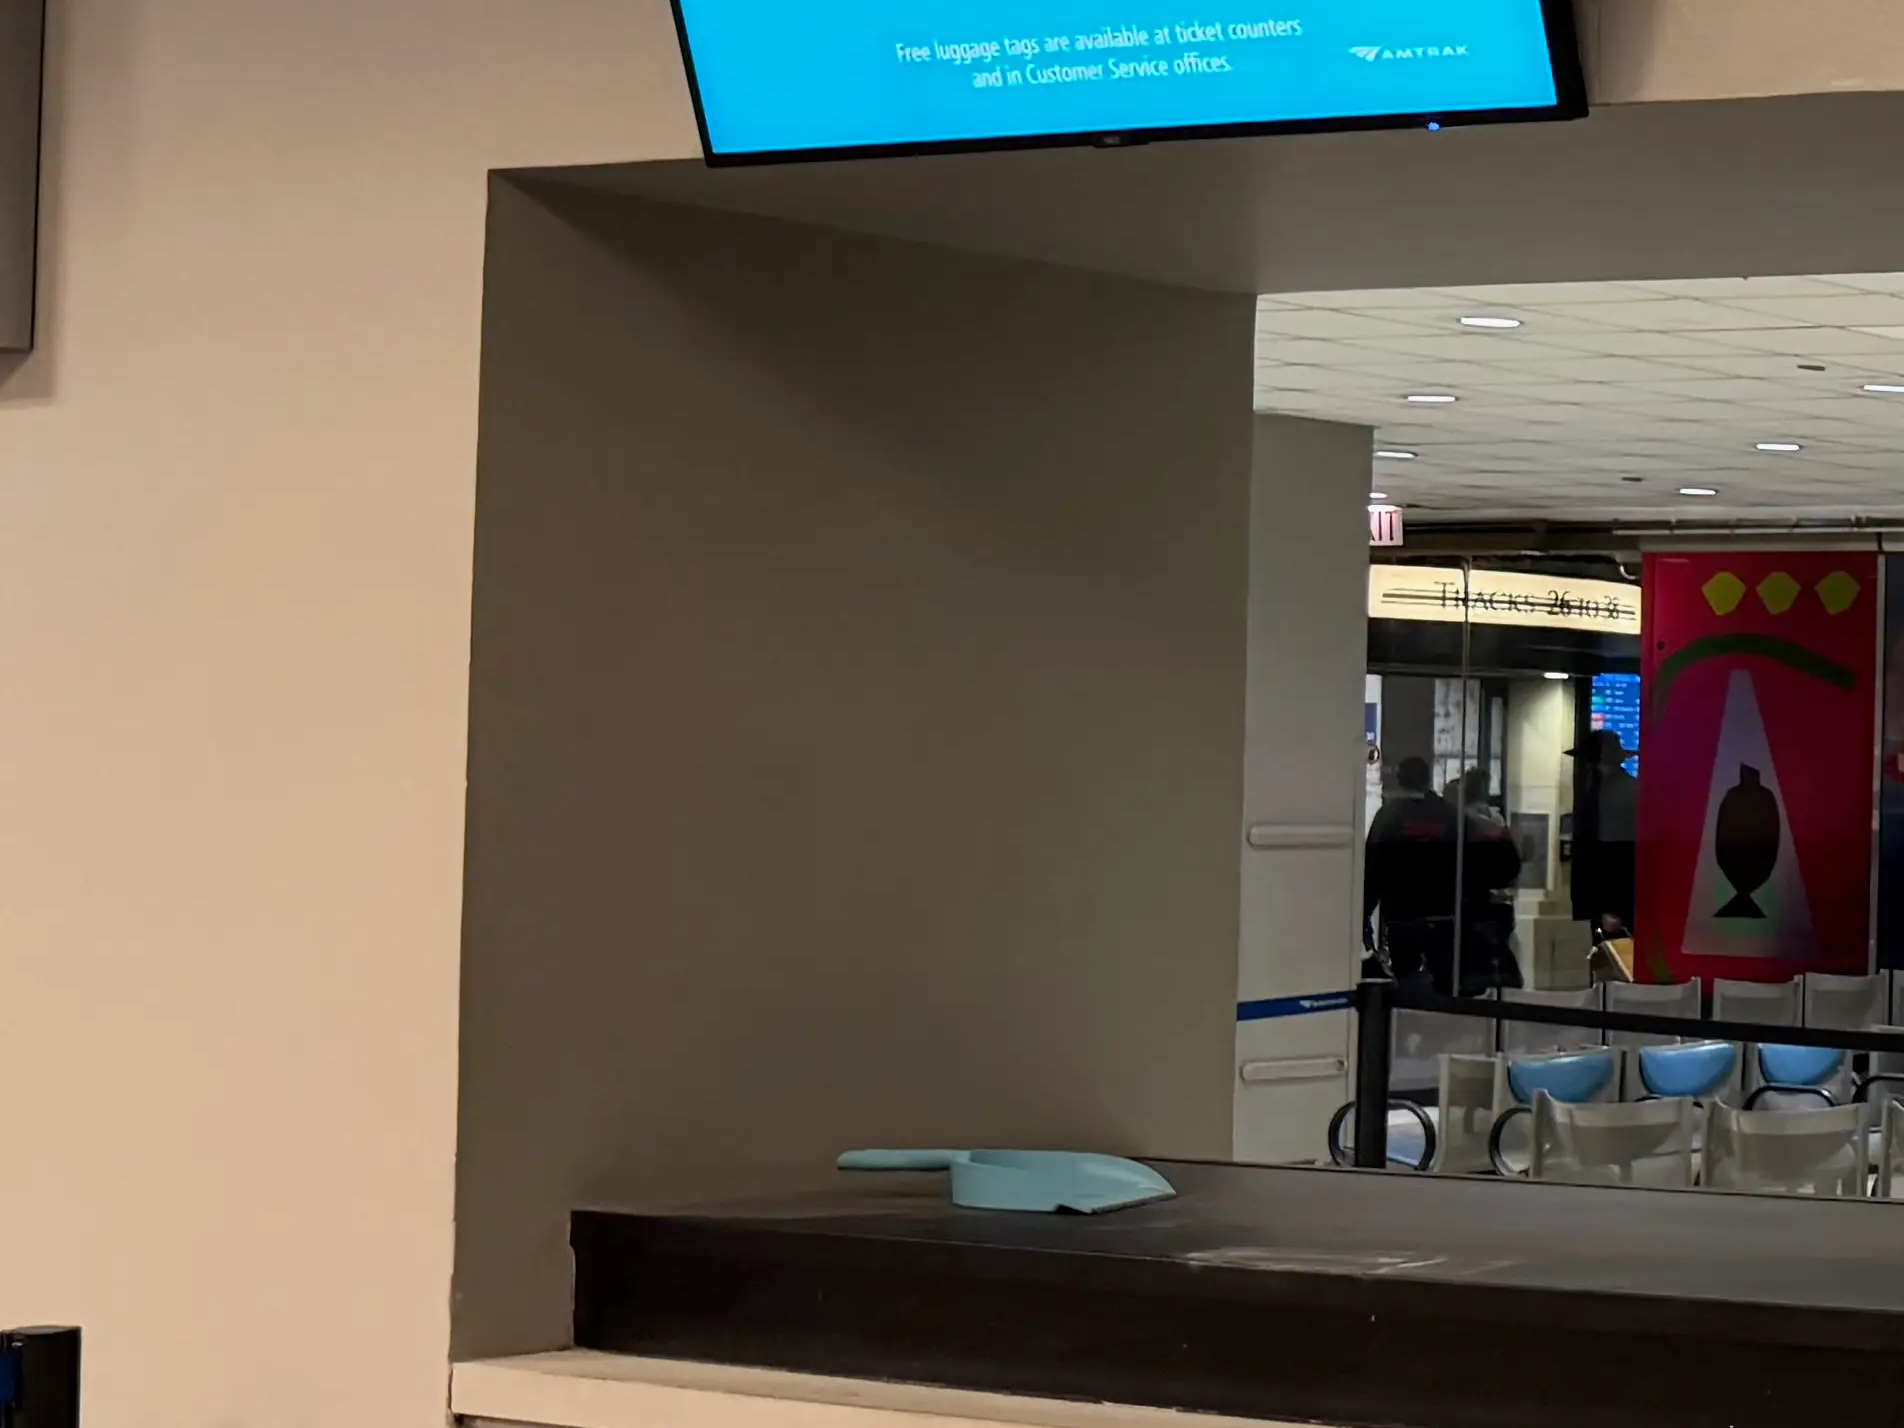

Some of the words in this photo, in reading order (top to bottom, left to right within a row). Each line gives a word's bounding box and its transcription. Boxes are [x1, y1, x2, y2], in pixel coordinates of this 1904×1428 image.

[896, 42, 931, 63] Free
[935, 39, 1000, 65] luggage
[1004, 37, 1040, 59] tags
[1044, 36, 1070, 53] are
[1075, 24, 1149, 50] available
[1153, 25, 1172, 46] at
[1175, 21, 1224, 45] ticket
[1228, 18, 1302, 41] counters
[1382, 44, 1469, 59] AMTRAK
[972, 66, 1003, 89] and
[1007, 66, 1023, 86] in
[1026, 62, 1104, 84] Customer
[1108, 56, 1169, 79] Service
[1173, 52, 1233, 76] offices.
[1370, 510, 1402, 542] IT
